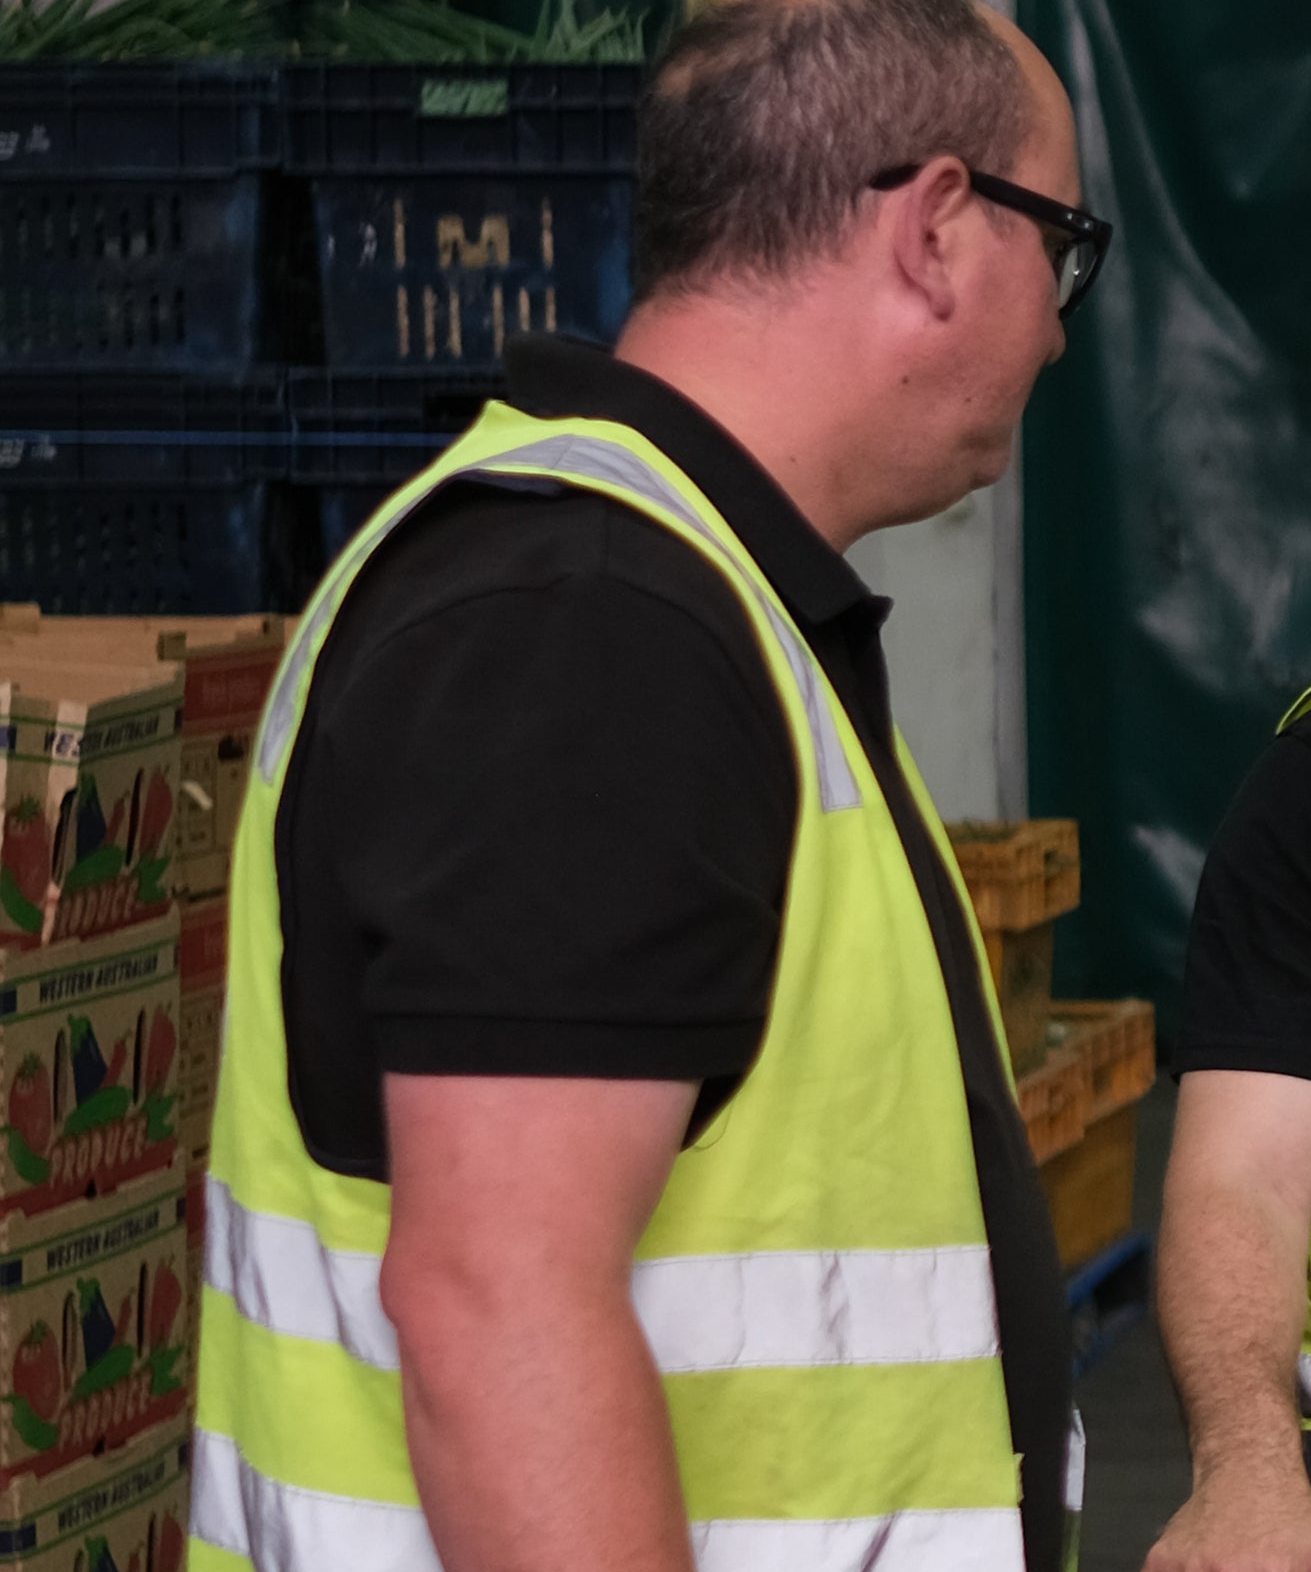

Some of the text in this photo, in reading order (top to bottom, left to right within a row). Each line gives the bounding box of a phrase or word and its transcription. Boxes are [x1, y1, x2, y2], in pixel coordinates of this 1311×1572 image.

[40, 953, 158, 1004] WESTERN AUSTRALIAN
[49, 1115, 148, 1190] PRODUCE
[47, 1209, 160, 1271] WESTERN AUSTRALIAN
[57, 1368, 151, 1453] PRODUCE
